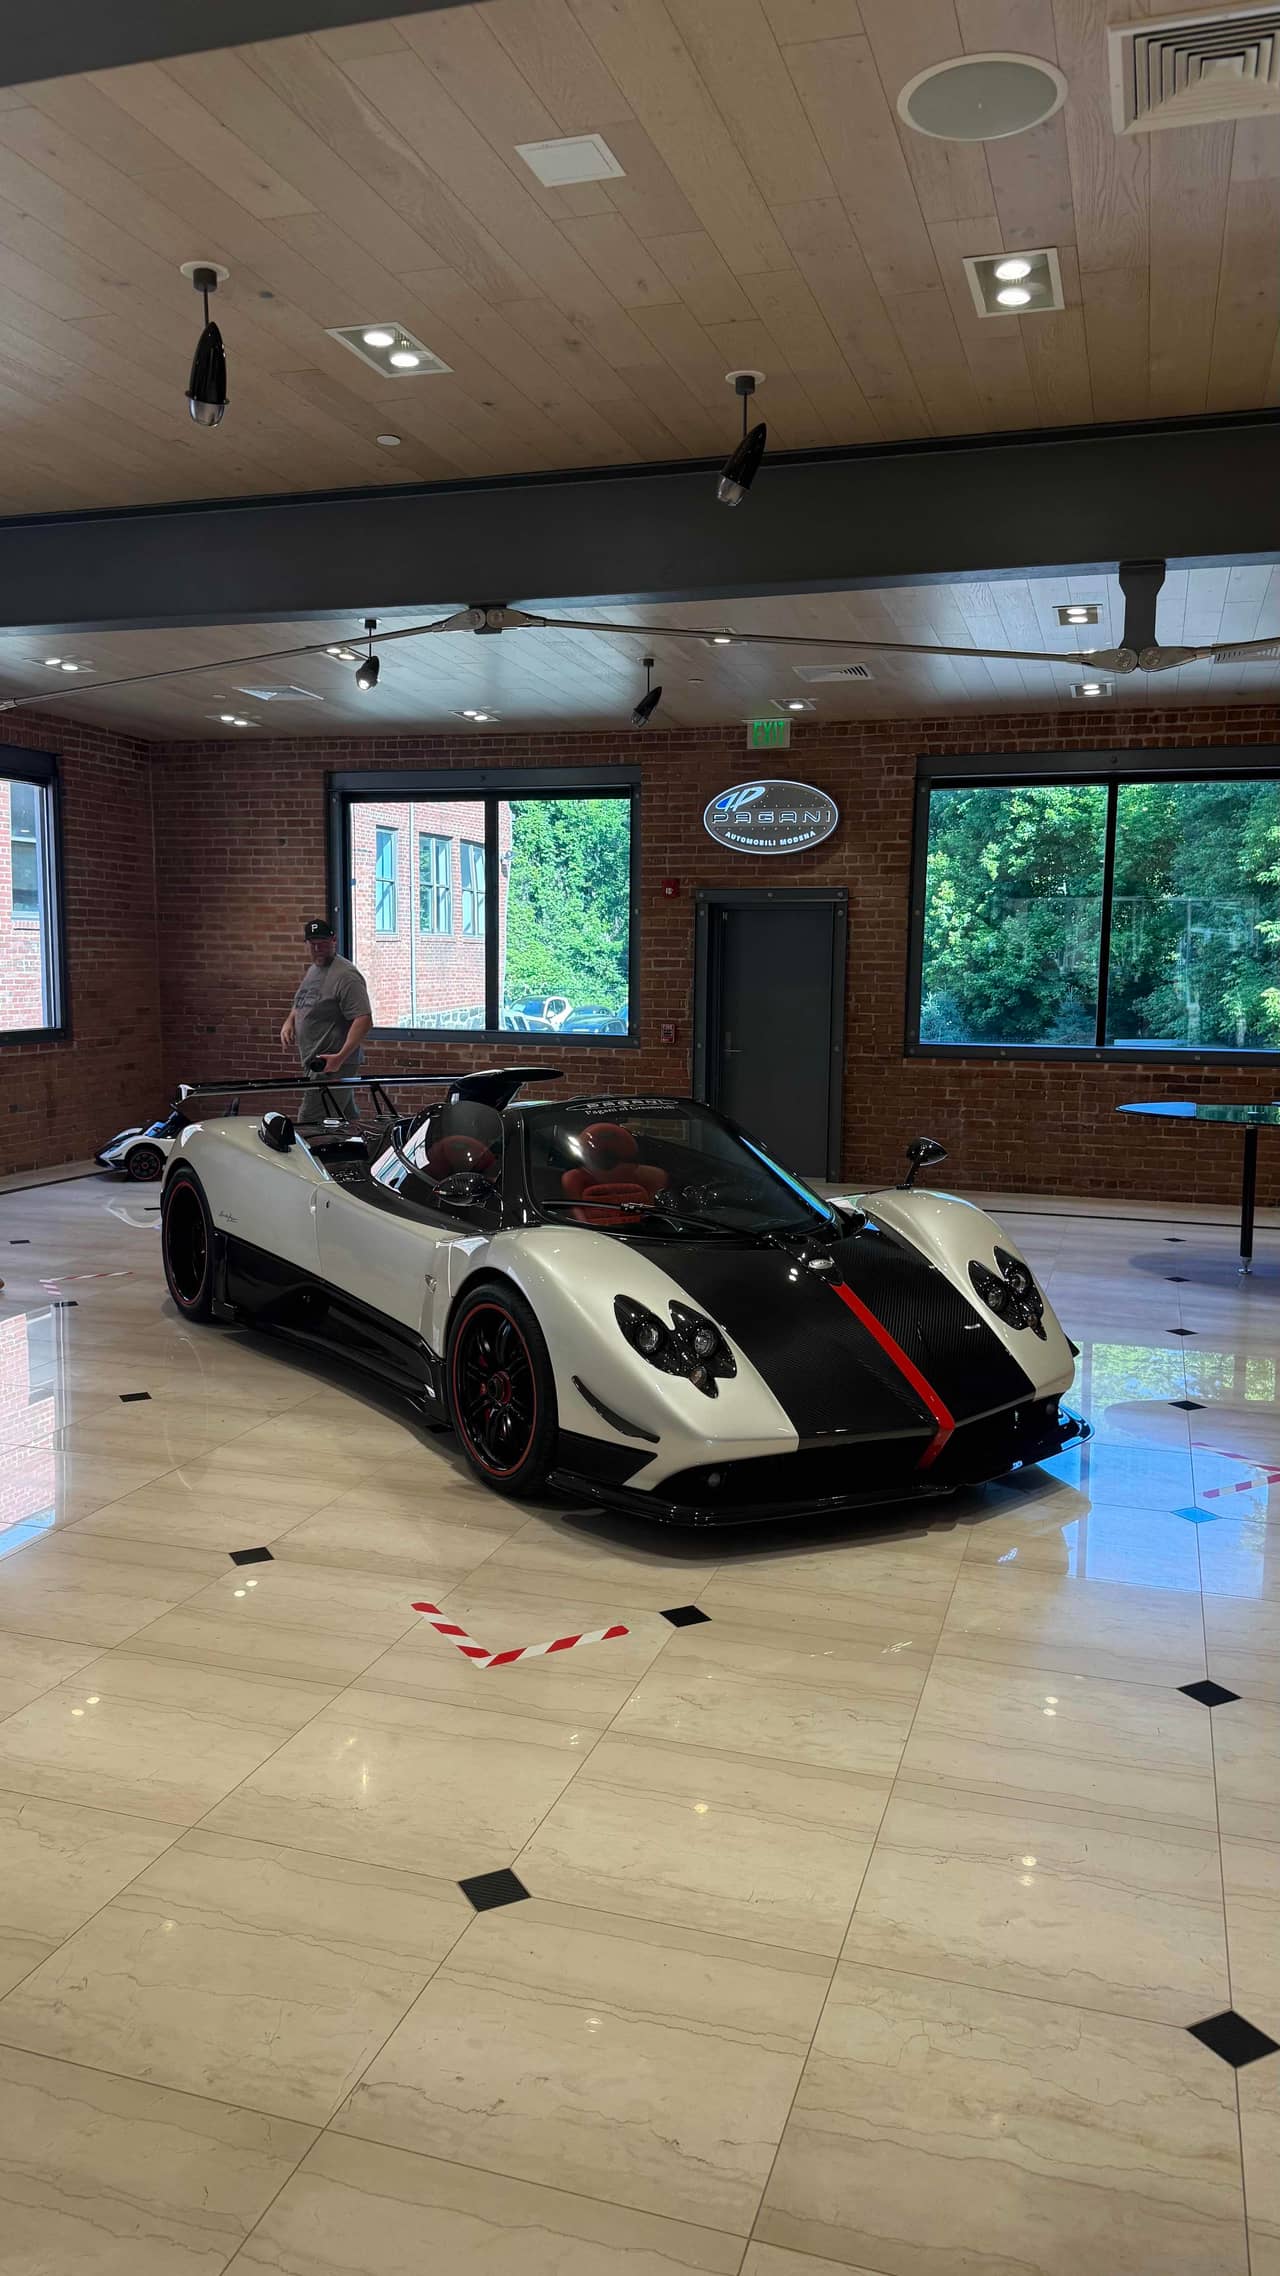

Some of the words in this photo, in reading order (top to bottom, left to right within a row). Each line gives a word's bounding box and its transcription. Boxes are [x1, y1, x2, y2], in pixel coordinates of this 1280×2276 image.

[753, 721, 784, 746] EXIT
[711, 810, 831, 824] PAGANI
[724, 831, 777, 847] AUTOMOBILI
[779, 830, 816, 846] MODENA
[311, 924, 318, 933] P
